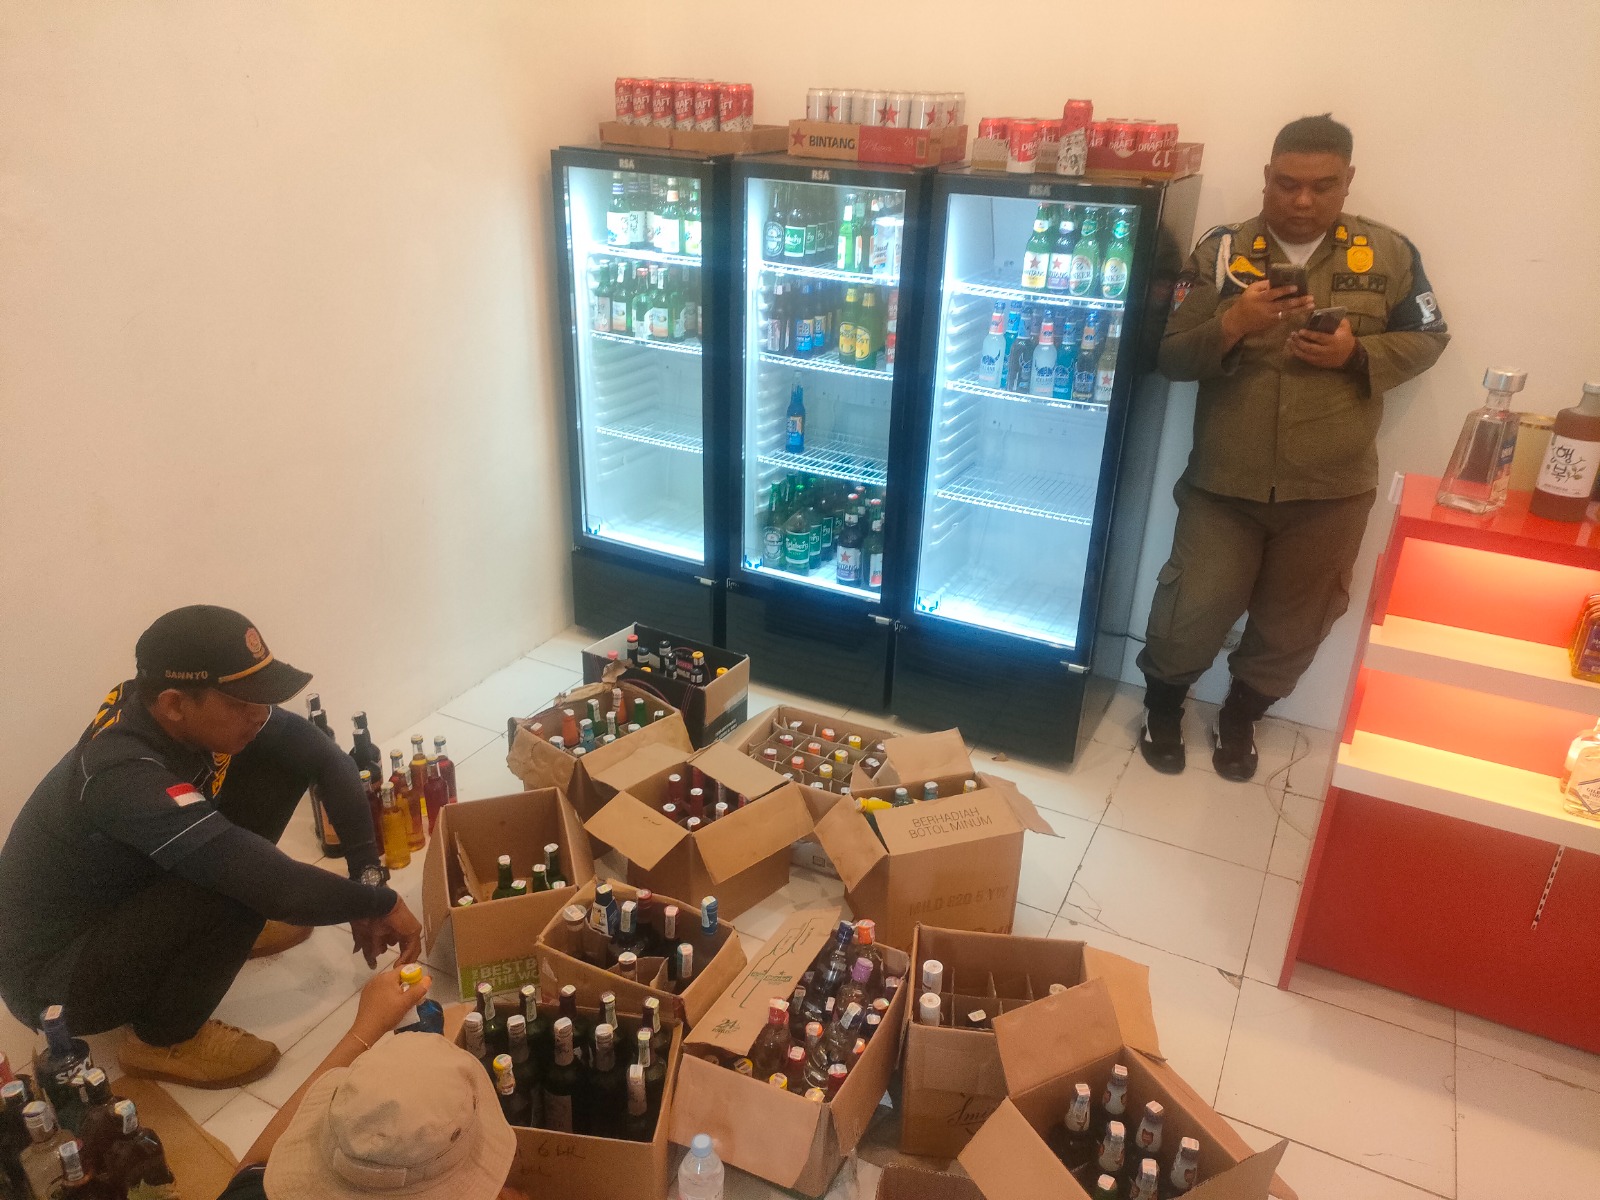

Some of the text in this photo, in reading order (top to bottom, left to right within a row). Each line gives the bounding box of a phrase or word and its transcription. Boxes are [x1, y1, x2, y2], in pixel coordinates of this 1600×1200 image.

[809, 135, 856, 150] BINTANG
[1416, 292, 1437, 325] P
[908, 815, 993, 839] BOTOL MINUM
[912, 807, 981, 829] BERHADIAH
